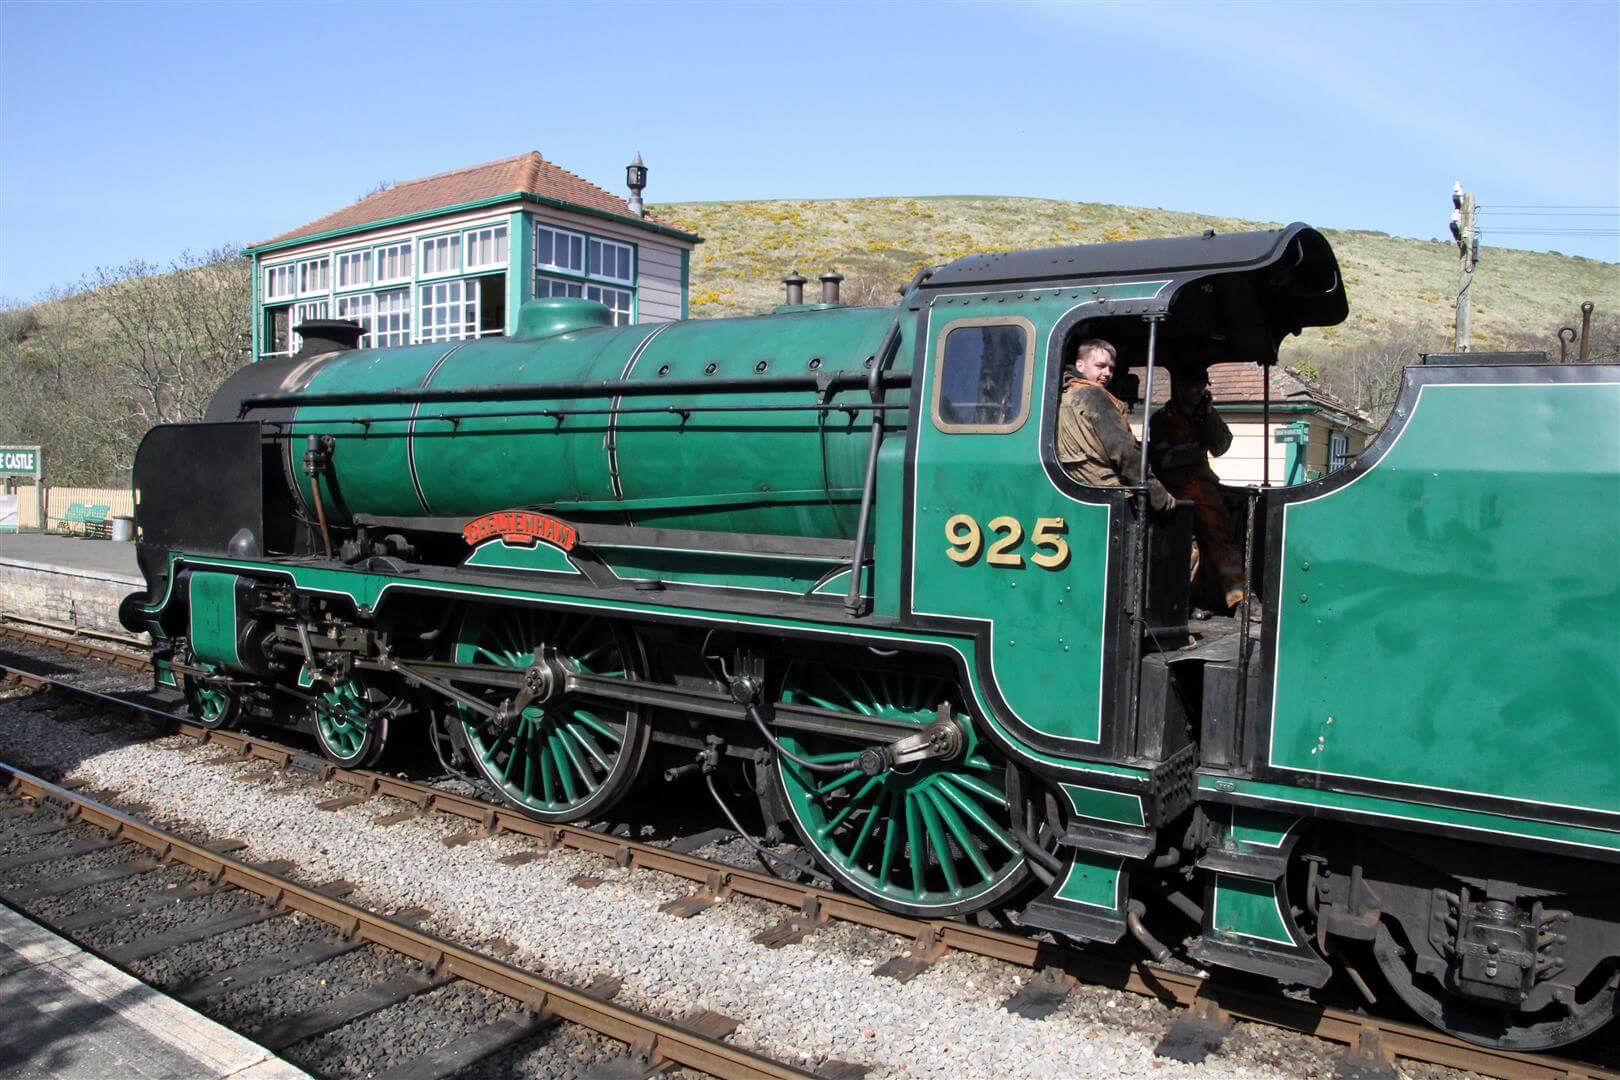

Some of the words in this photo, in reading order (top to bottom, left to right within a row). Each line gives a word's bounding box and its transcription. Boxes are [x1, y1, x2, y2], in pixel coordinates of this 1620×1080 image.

[5, 453, 34, 470] CASTLE
[468, 511, 570, 545] CHELTENHAM
[945, 514, 1070, 569] 925
